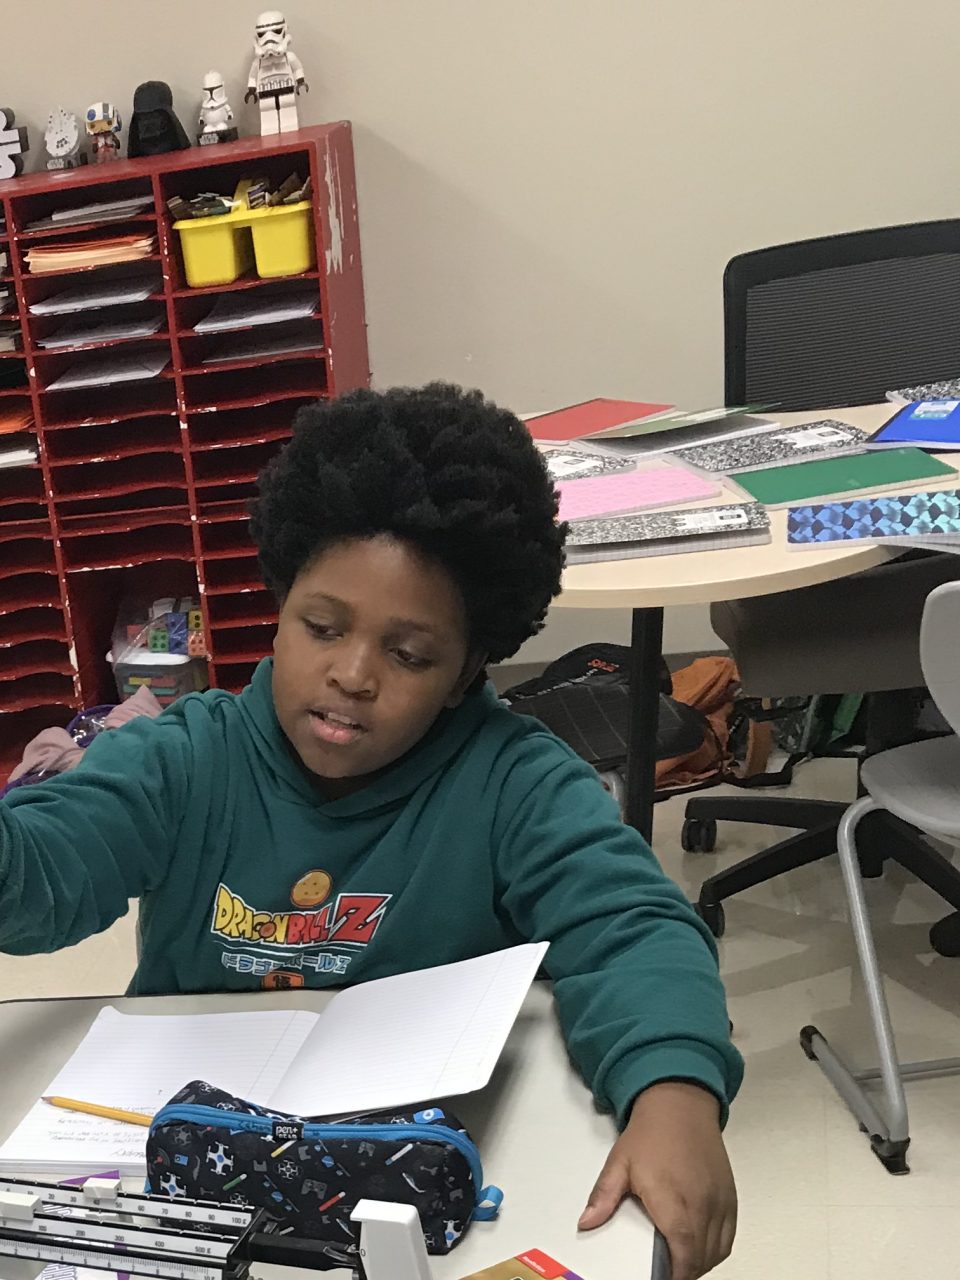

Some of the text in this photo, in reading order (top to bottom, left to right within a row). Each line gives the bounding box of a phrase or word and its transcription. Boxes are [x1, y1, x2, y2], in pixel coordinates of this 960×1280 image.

[211, 883, 392, 946] DRAGON BALL Z
